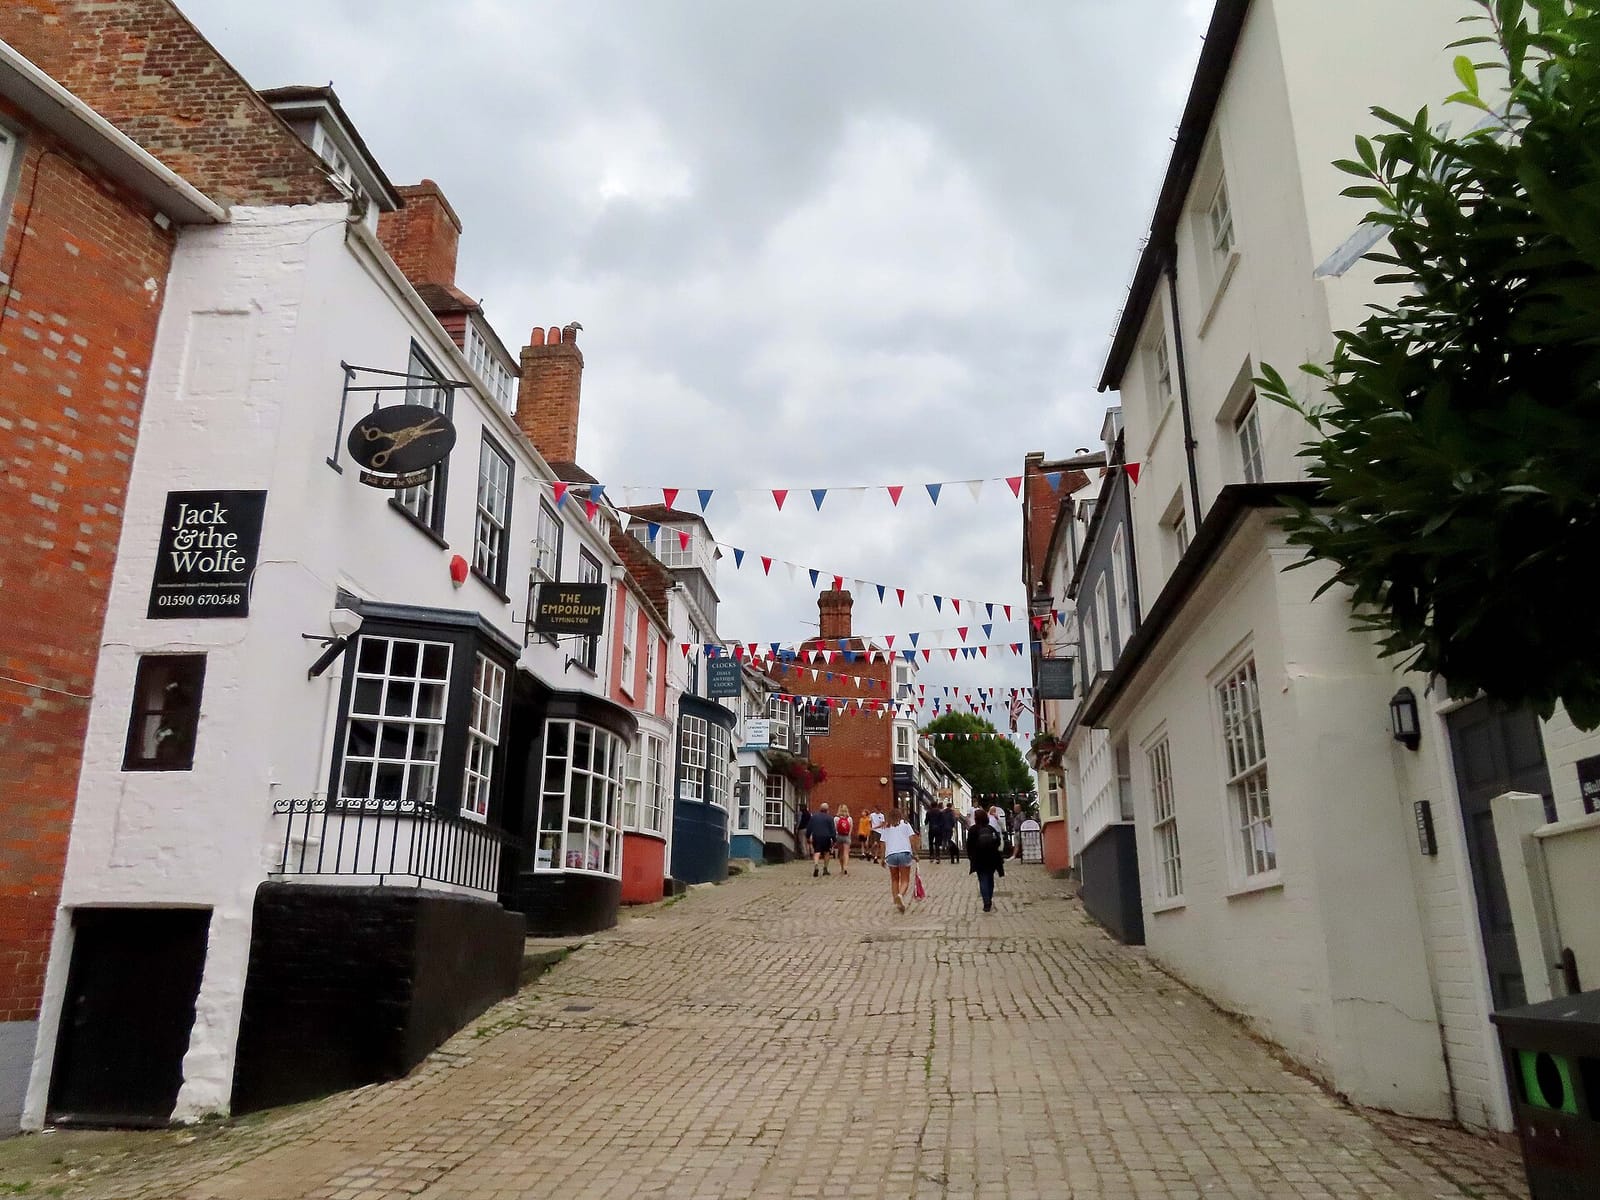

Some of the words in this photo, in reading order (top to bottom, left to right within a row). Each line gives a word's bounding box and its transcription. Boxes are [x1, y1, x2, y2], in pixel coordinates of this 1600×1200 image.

[393, 479, 405, 487] the
[171, 502, 228, 531] Jack
[170, 549, 246, 573] Wolfe
[158, 595, 195, 606] 01590
[197, 594, 241, 605] 670548
[559, 593, 581, 603] THE
[541, 604, 601, 616] EMPORIUM
[551, 616, 589, 624] LYMINGTON
